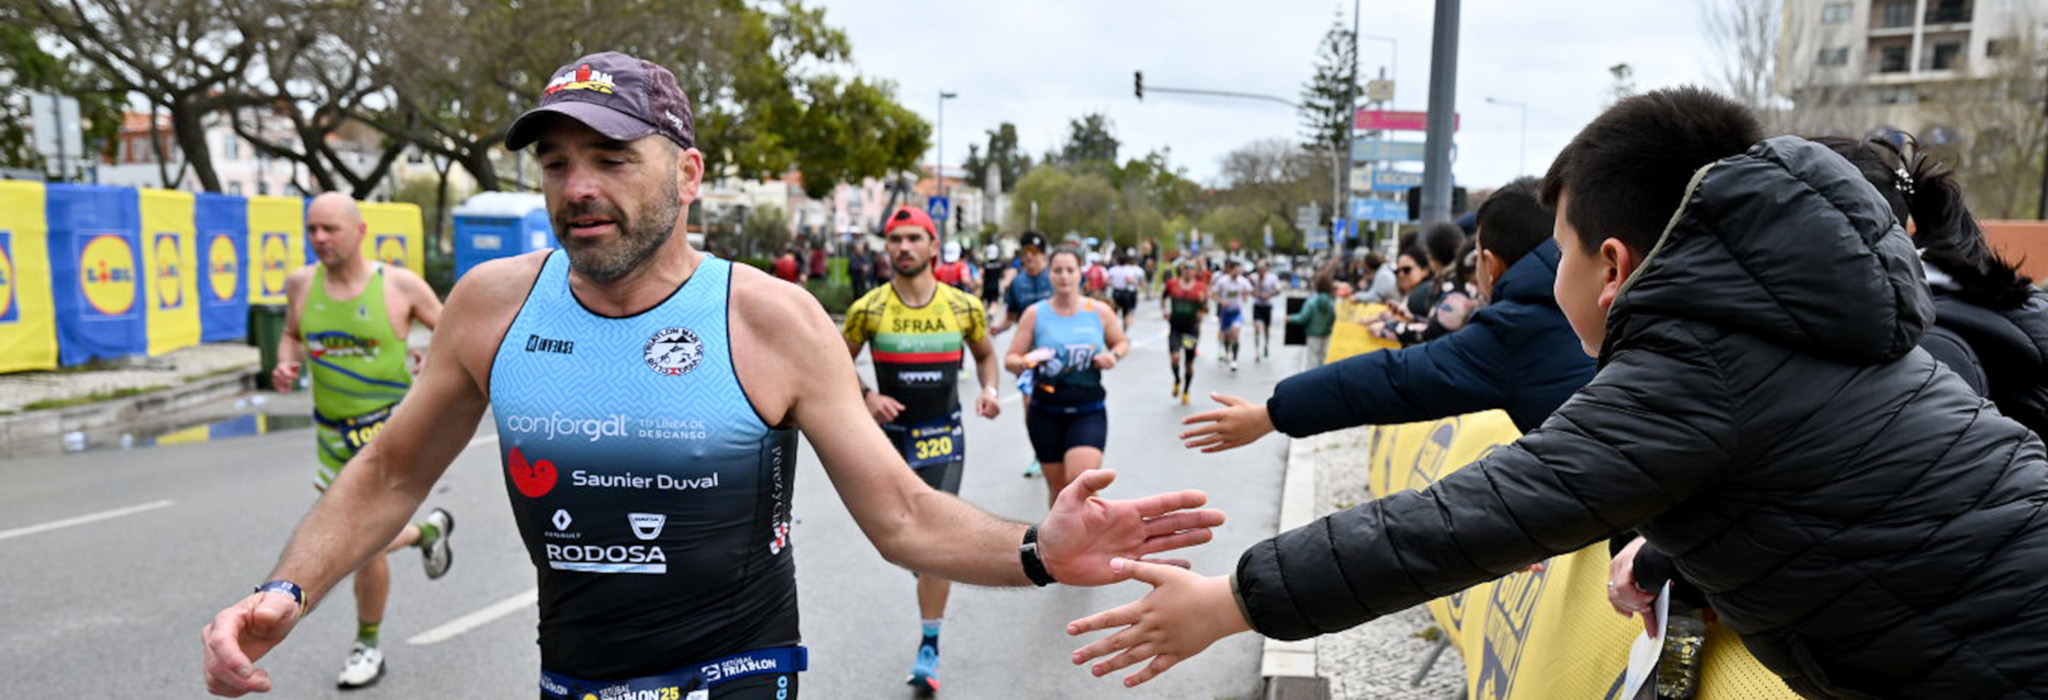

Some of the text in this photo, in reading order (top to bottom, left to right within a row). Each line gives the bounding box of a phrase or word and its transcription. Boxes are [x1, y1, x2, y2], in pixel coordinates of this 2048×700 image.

[892, 319, 947, 332] SFRAA
[638, 429, 706, 440] DESCANSO
[916, 436, 953, 460] 320
[571, 470, 719, 491] Saunier Duval
[545, 544, 667, 563] RODOSA
[722, 659, 776, 677] TRIATHLON
